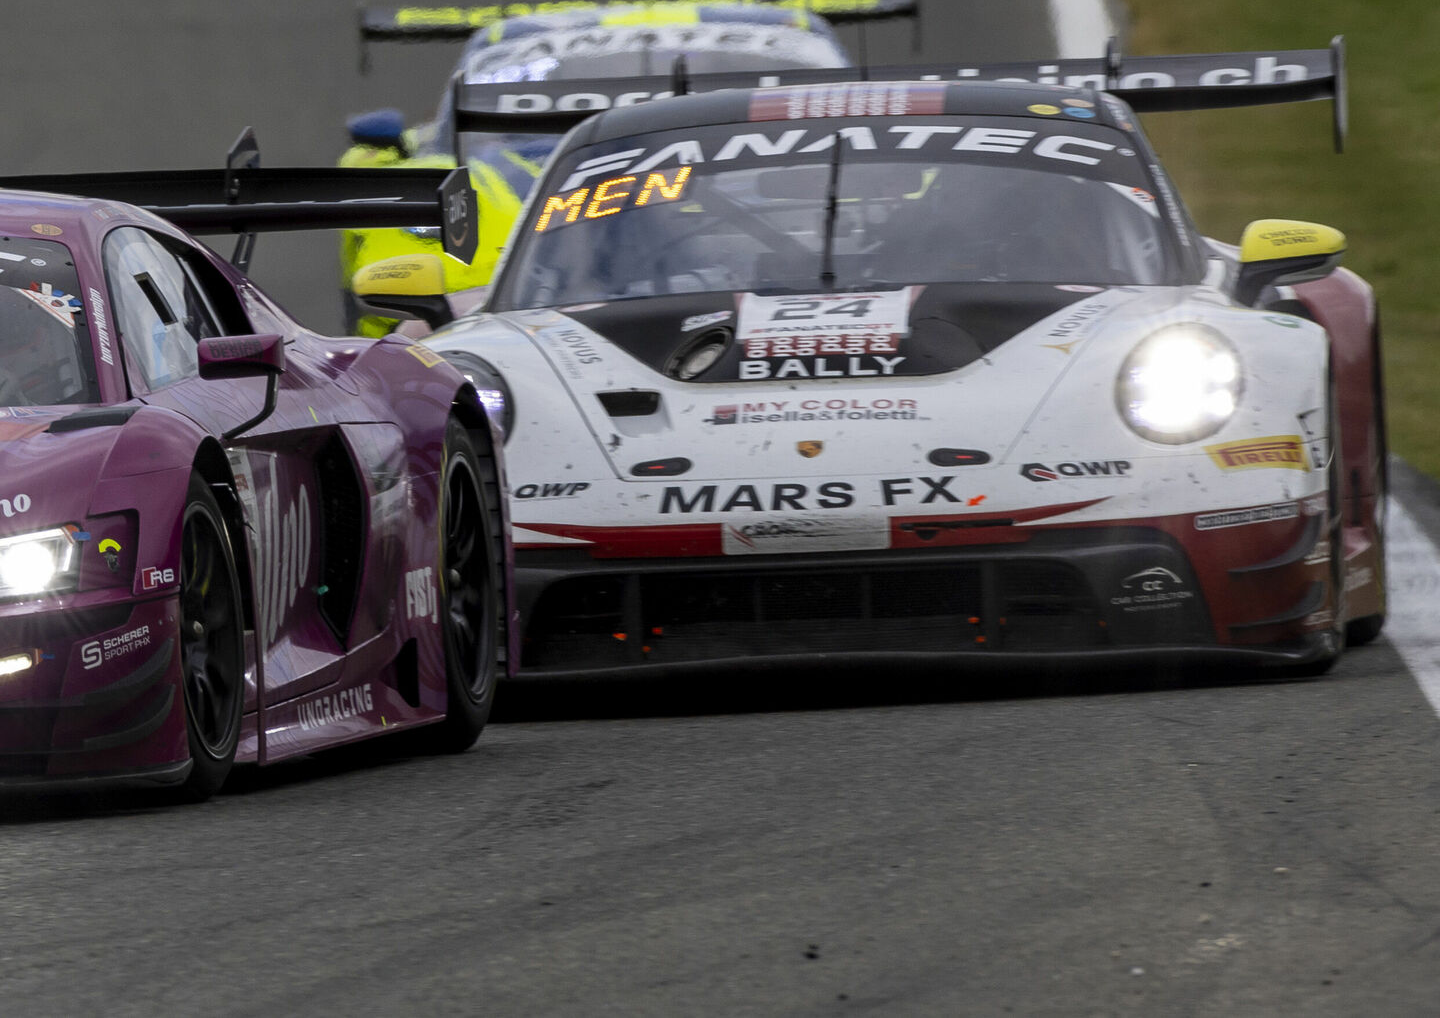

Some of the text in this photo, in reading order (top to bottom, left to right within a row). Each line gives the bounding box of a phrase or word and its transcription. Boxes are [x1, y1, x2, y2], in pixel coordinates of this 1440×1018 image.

[560, 125, 1116, 193] FANATEC
[535, 166, 692, 232] MEN
[771, 299, 876, 321] 24
[1048, 302, 1109, 338] NOVUS
[559, 328, 604, 366] NOVUS
[739, 356, 907, 380] BALLY
[743, 398, 918, 413] MY COLOR
[1218, 440, 1303, 467] PIRELLI
[1056, 460, 1133, 476] QWP
[514, 482, 591, 500] QWP
[659, 475, 963, 513] MARS FX
[103, 625, 150, 650] SCHERER
[104, 635, 151, 660] SPORT PHX
[297, 684, 374, 731] UNORACING
